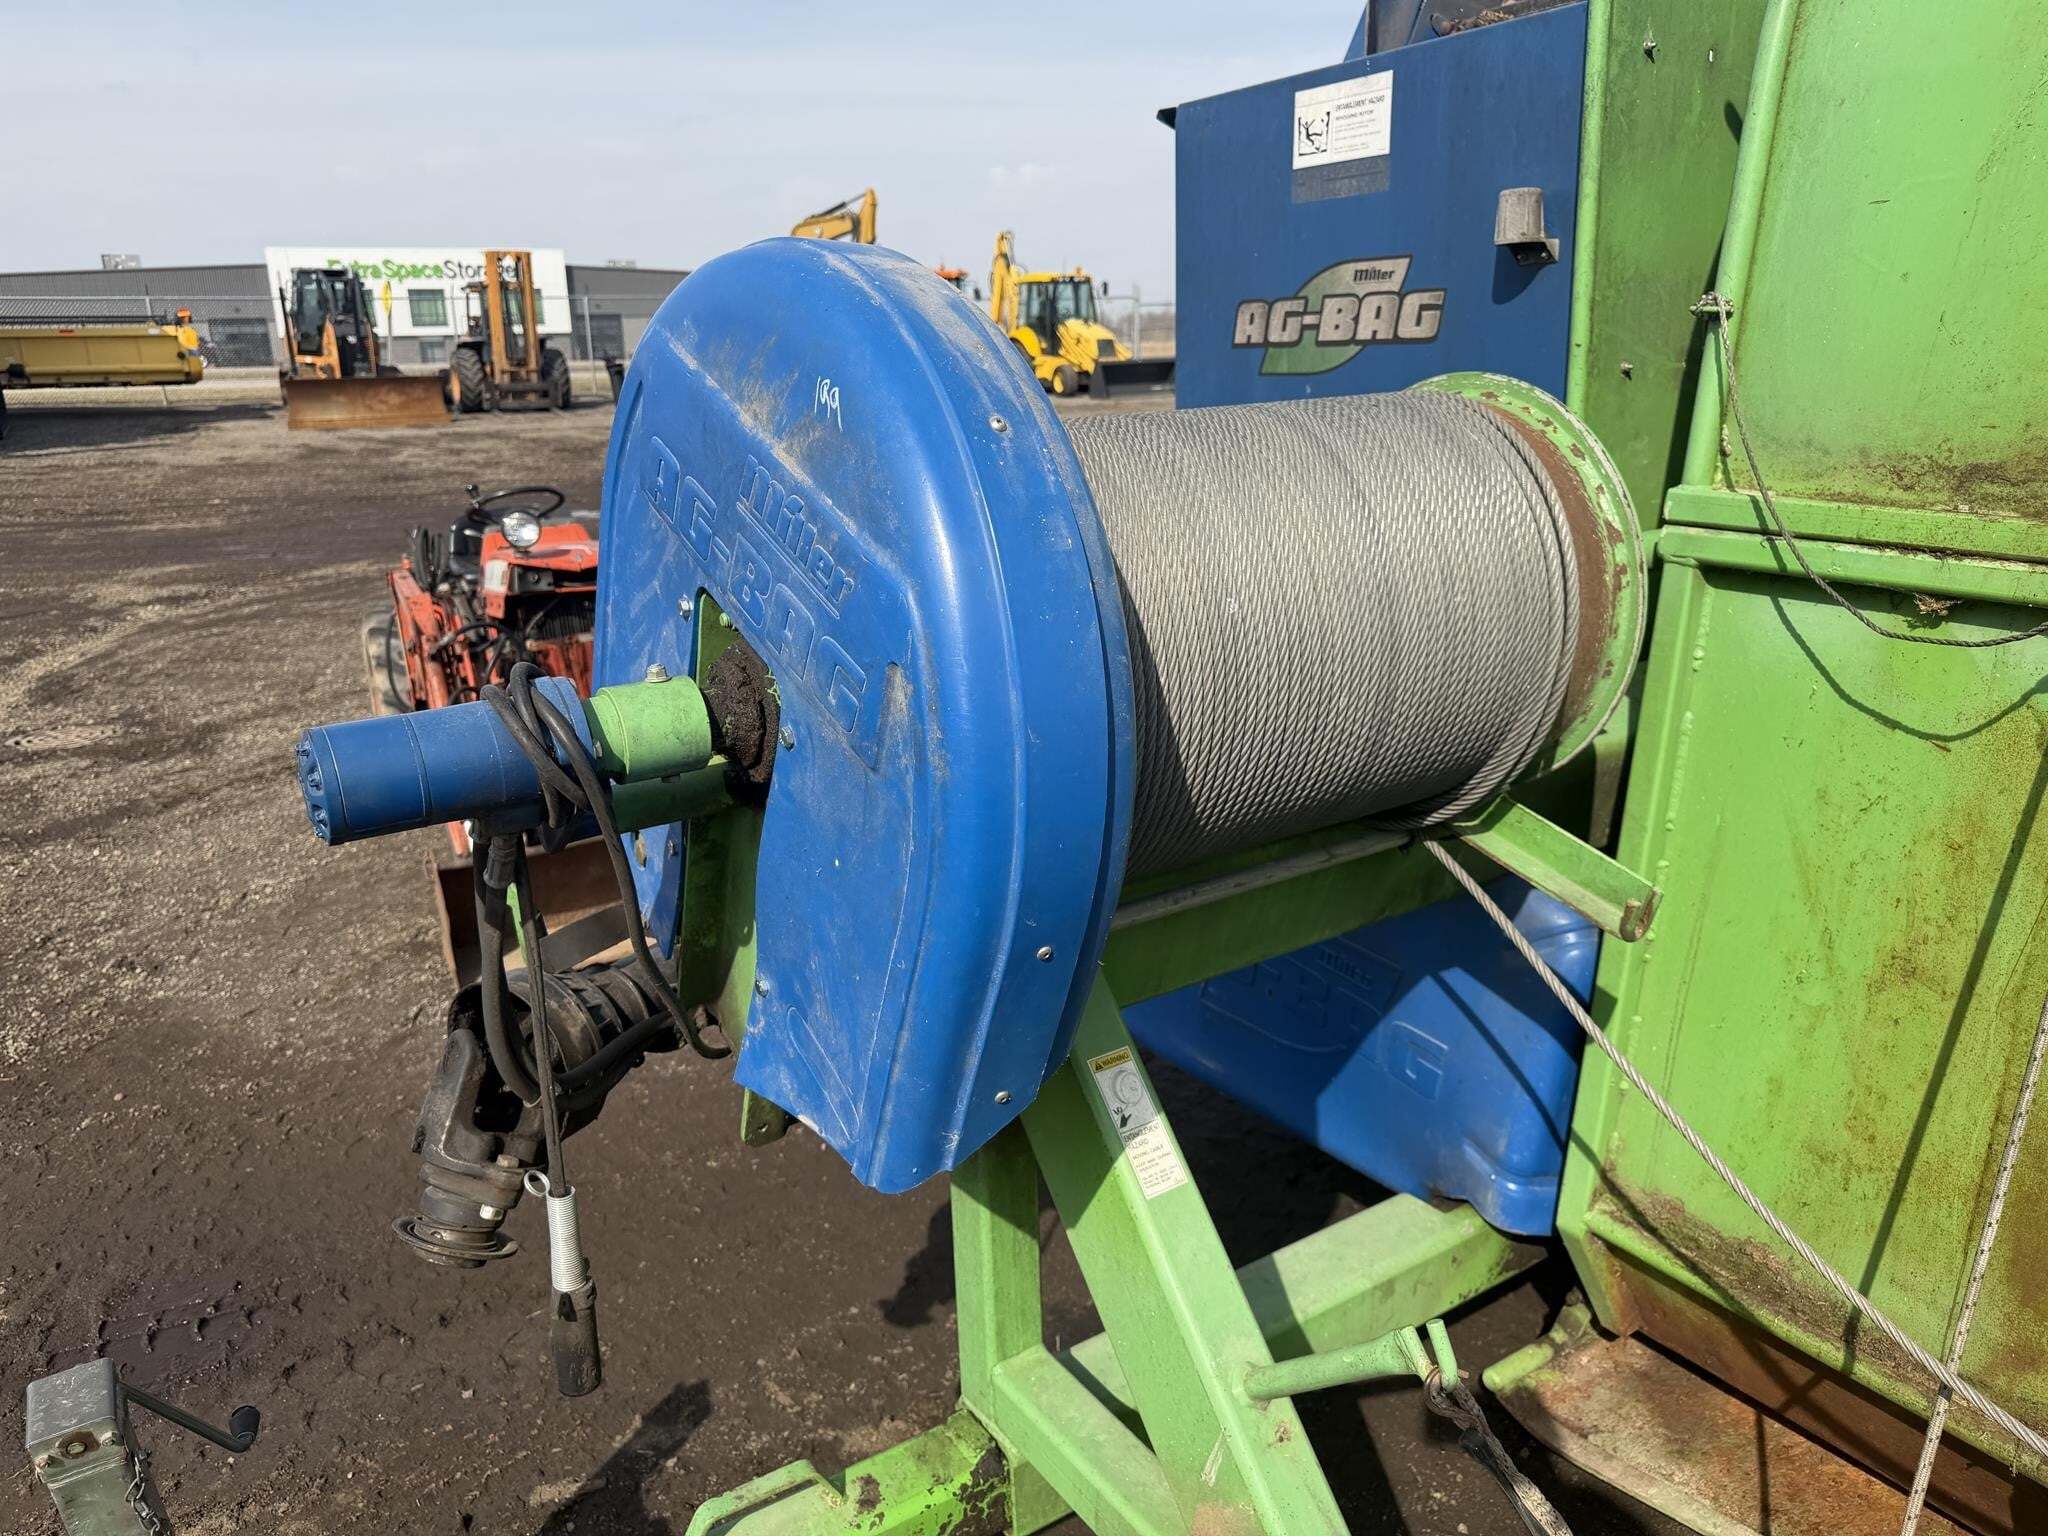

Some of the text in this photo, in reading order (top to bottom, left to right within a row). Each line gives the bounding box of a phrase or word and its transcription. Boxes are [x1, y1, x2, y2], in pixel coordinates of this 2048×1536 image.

[1353, 265, 1396, 284] Miller
[1232, 288, 1447, 348] AG-BAG
[641, 436, 867, 734] AG-BAG
